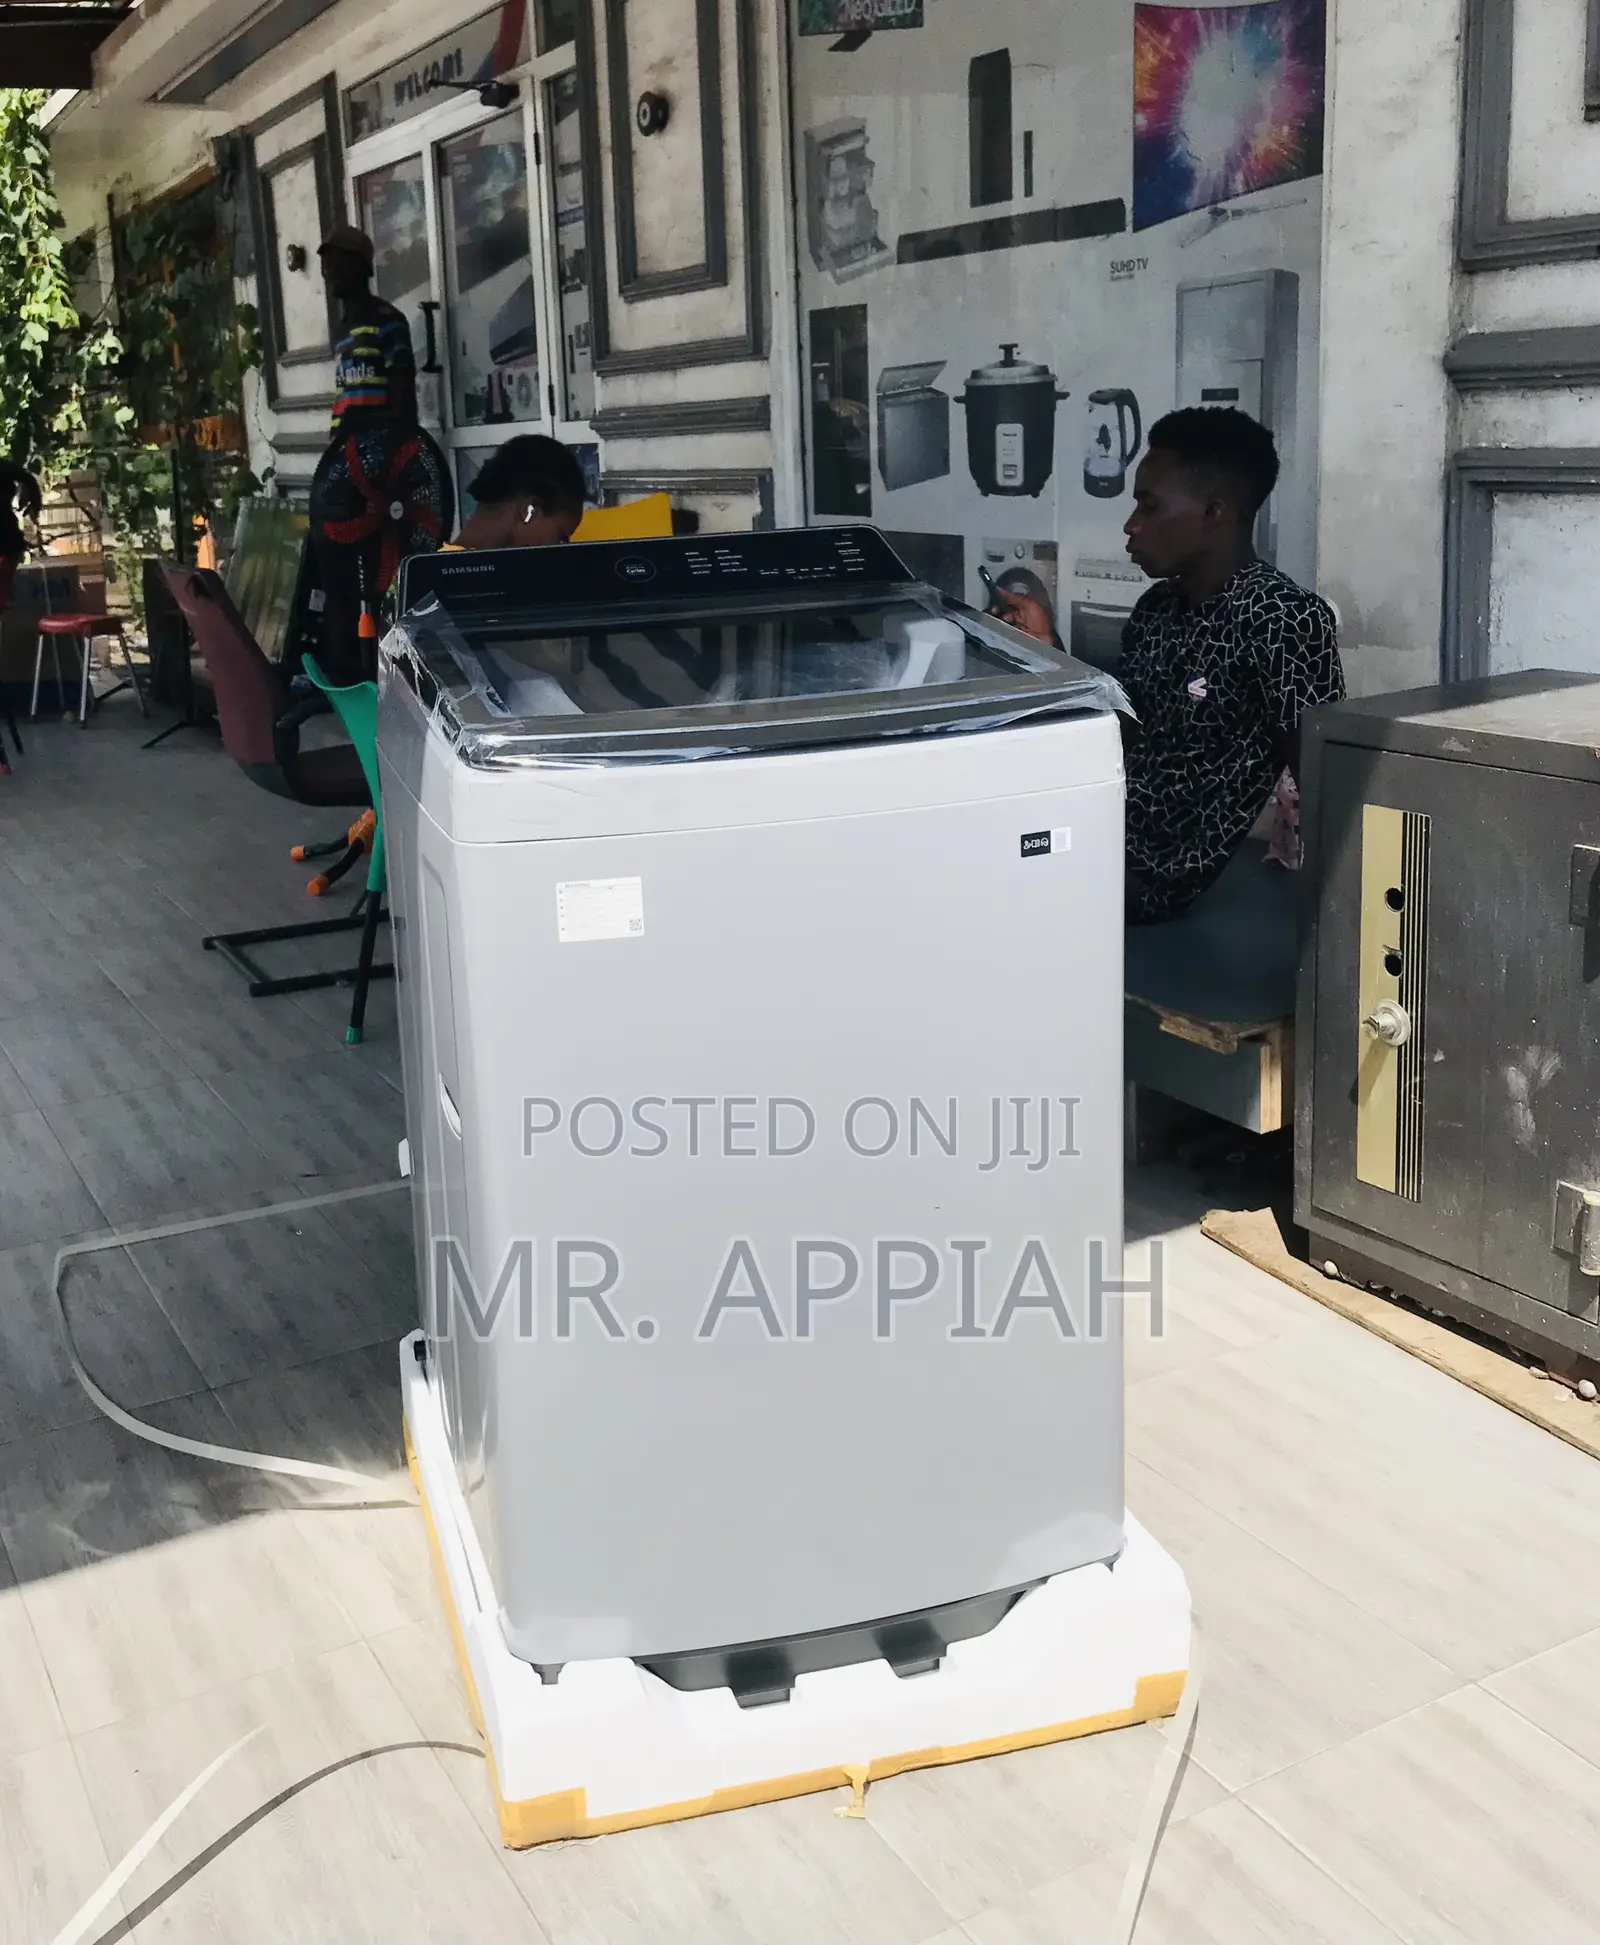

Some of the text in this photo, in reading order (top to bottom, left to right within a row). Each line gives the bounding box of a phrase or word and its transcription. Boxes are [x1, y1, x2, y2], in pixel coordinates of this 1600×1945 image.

[395, 48, 463, 107] WELCOME
[1110, 257, 1149, 274] SUHD TV
[441, 564, 495, 575] SAMSUNG
